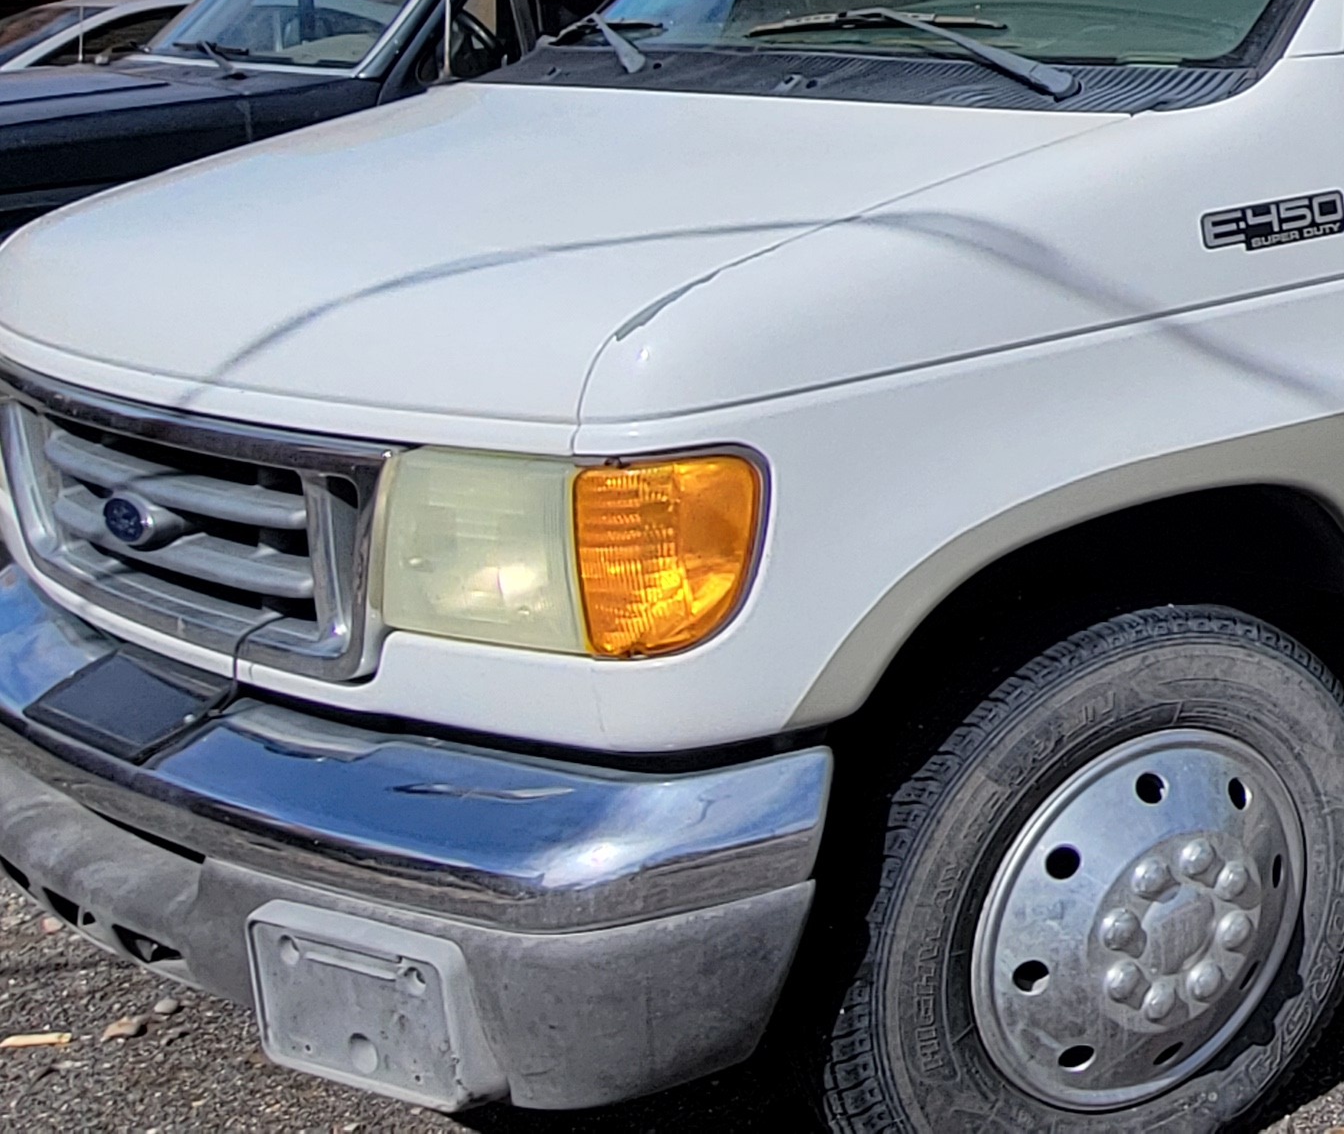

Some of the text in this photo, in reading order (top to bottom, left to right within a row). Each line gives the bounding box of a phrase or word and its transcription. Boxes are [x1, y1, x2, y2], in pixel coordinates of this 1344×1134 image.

[1203, 193, 1344, 247] E-450
[1251, 222, 1341, 248] SUPER DUTY
